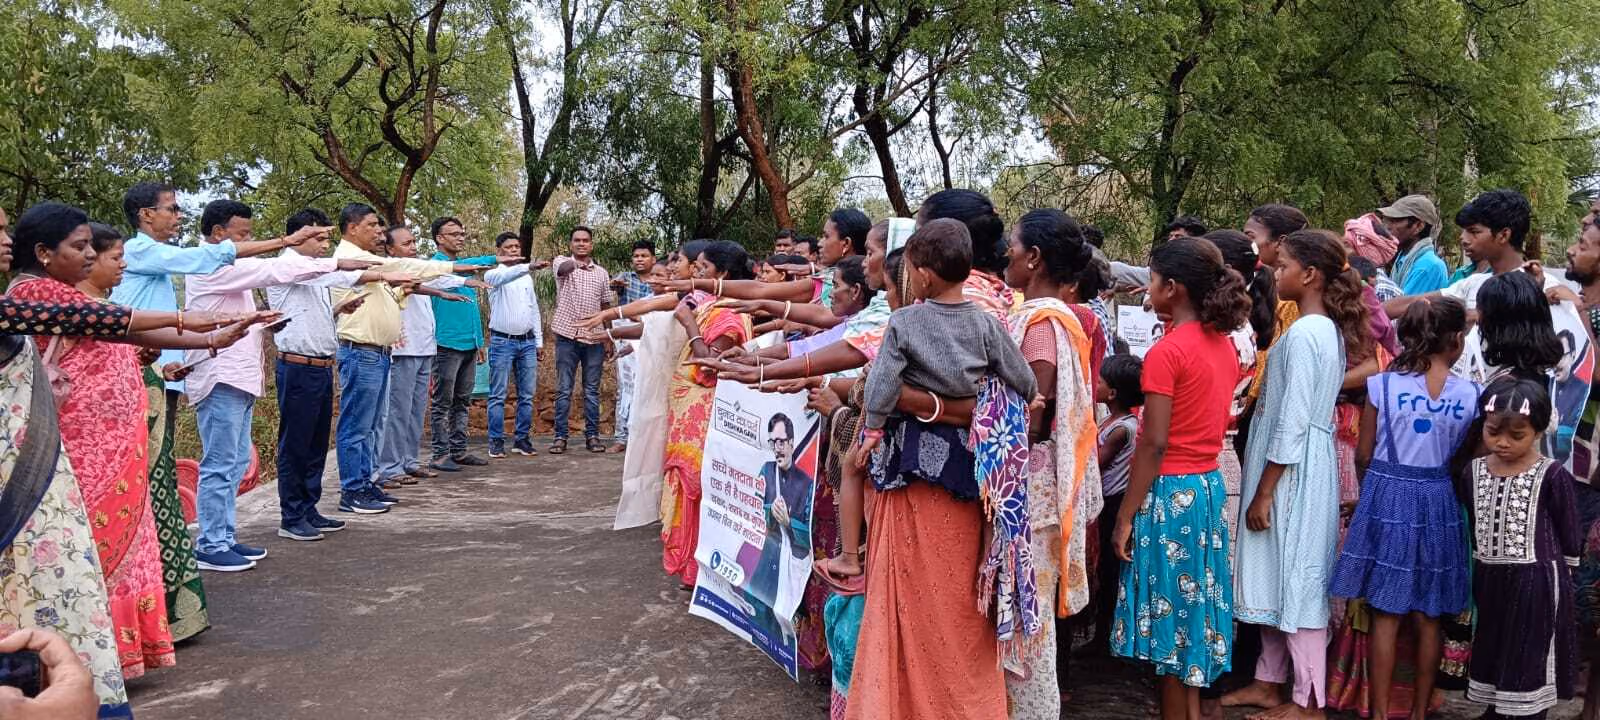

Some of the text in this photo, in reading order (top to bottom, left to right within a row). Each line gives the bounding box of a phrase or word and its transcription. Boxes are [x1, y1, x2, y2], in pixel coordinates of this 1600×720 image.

[1397, 392, 1465, 420] Fruit
[710, 476, 723, 491] एक
[724, 480, 731, 496] ही
[733, 483, 738, 499] है
[727, 465, 753, 488] मतदाता
[720, 564, 738, 582] 1950
